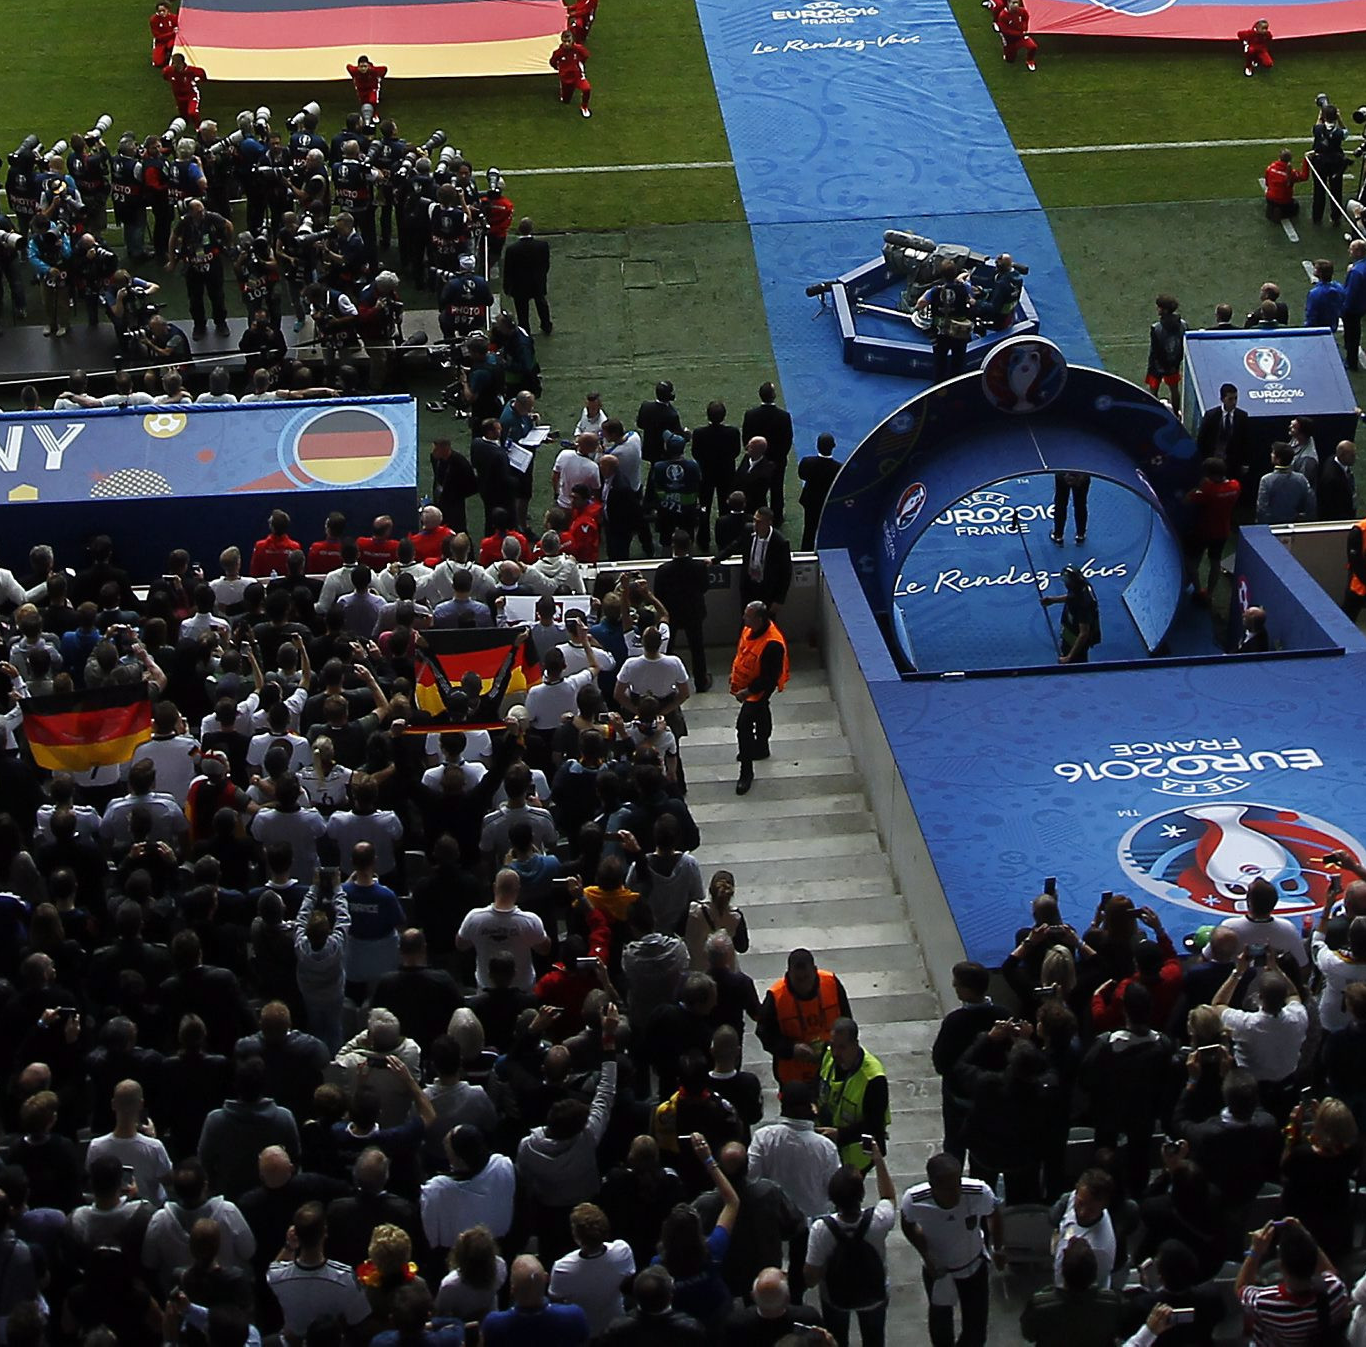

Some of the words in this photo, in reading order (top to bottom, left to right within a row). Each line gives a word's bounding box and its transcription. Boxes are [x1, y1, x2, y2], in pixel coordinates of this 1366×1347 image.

[772, 6, 880, 21] EURO2016
[801, 16, 855, 26] FRANCE
[751, 41, 779, 55] Le
[782, 32, 921, 53] Rendez-Vous
[451, 305, 481, 316] PHOTO
[1247, 389, 1305, 399] EURO2016
[958, 490, 1012, 509] UEFA
[930, 501, 1057, 531] URO2016
[954, 522, 1032, 537] FRANCE
[891, 572, 927, 598] Le
[1110, 737, 1243, 758] FRANCE
[1053, 747, 1324, 784] EURO2016
[1161, 776, 1236, 795] UEFA
